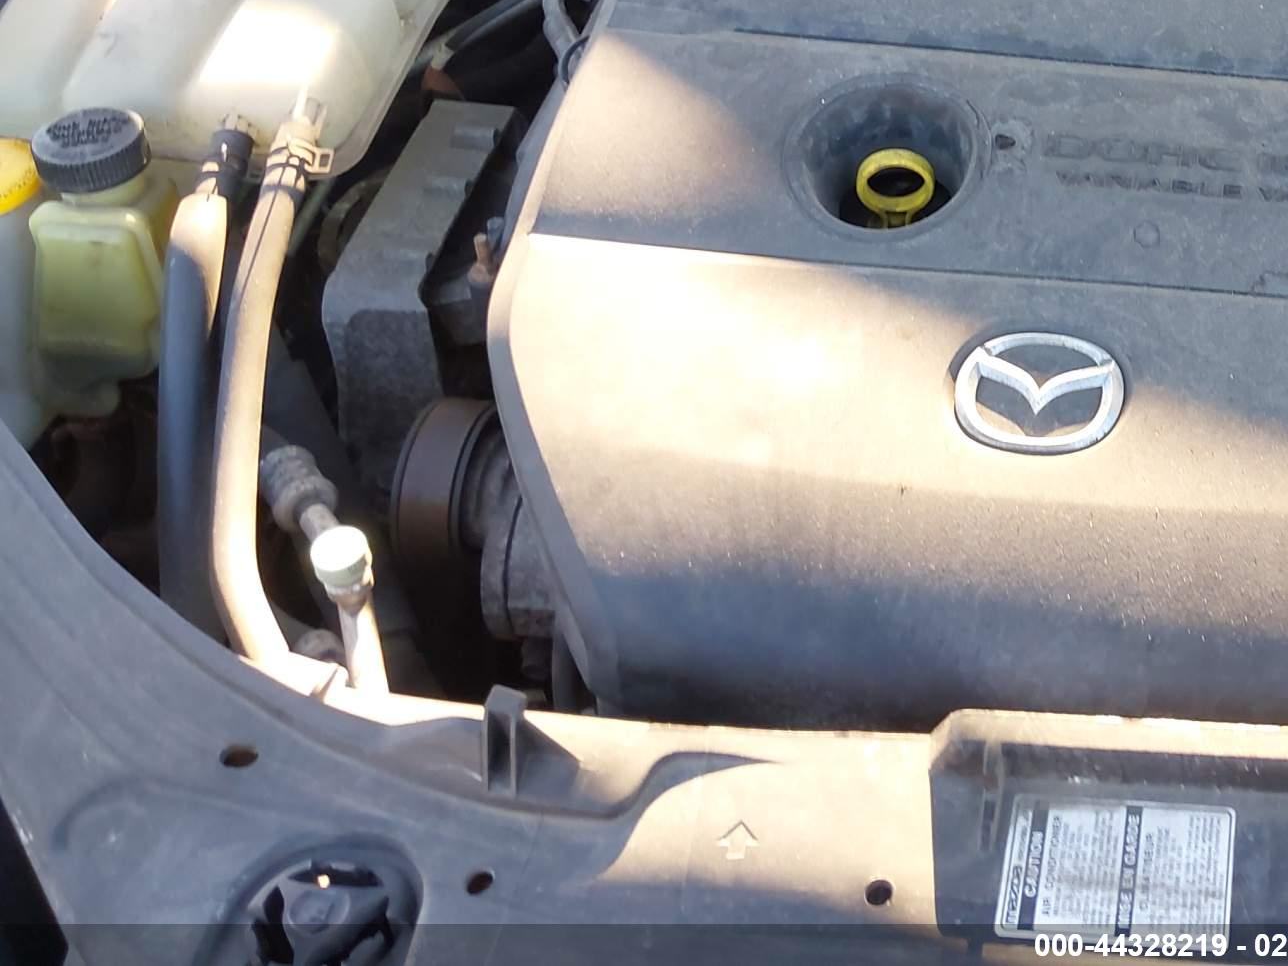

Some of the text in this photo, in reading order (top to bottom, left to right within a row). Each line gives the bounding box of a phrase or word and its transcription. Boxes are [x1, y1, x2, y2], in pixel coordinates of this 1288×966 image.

[1045, 133, 1243, 173] DOHC
[1057, 170, 1244, 200] VARIABLE
[1124, 813, 1140, 866] GARDE
[1024, 831, 1044, 898] CAUTION
[1118, 890, 1133, 930] MISE
